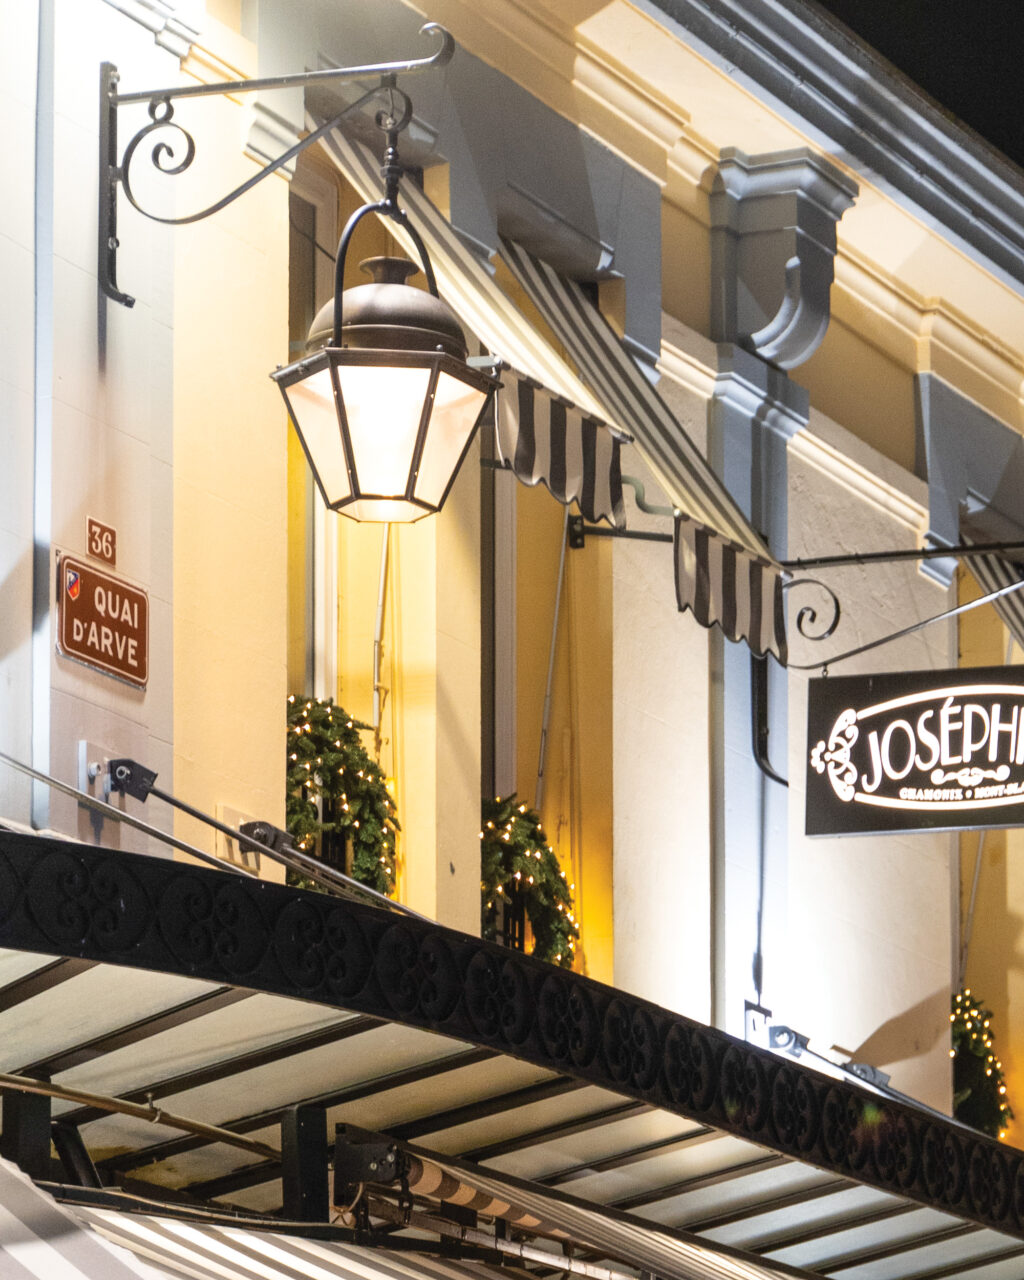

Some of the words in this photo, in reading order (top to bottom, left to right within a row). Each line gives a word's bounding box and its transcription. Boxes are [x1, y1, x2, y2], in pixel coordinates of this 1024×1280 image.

[91, 525, 112, 558] 36
[94, 586, 139, 628] QUAI
[73, 618, 138, 667] D'ARVE
[899, 787, 963, 800] CHAMONIX
